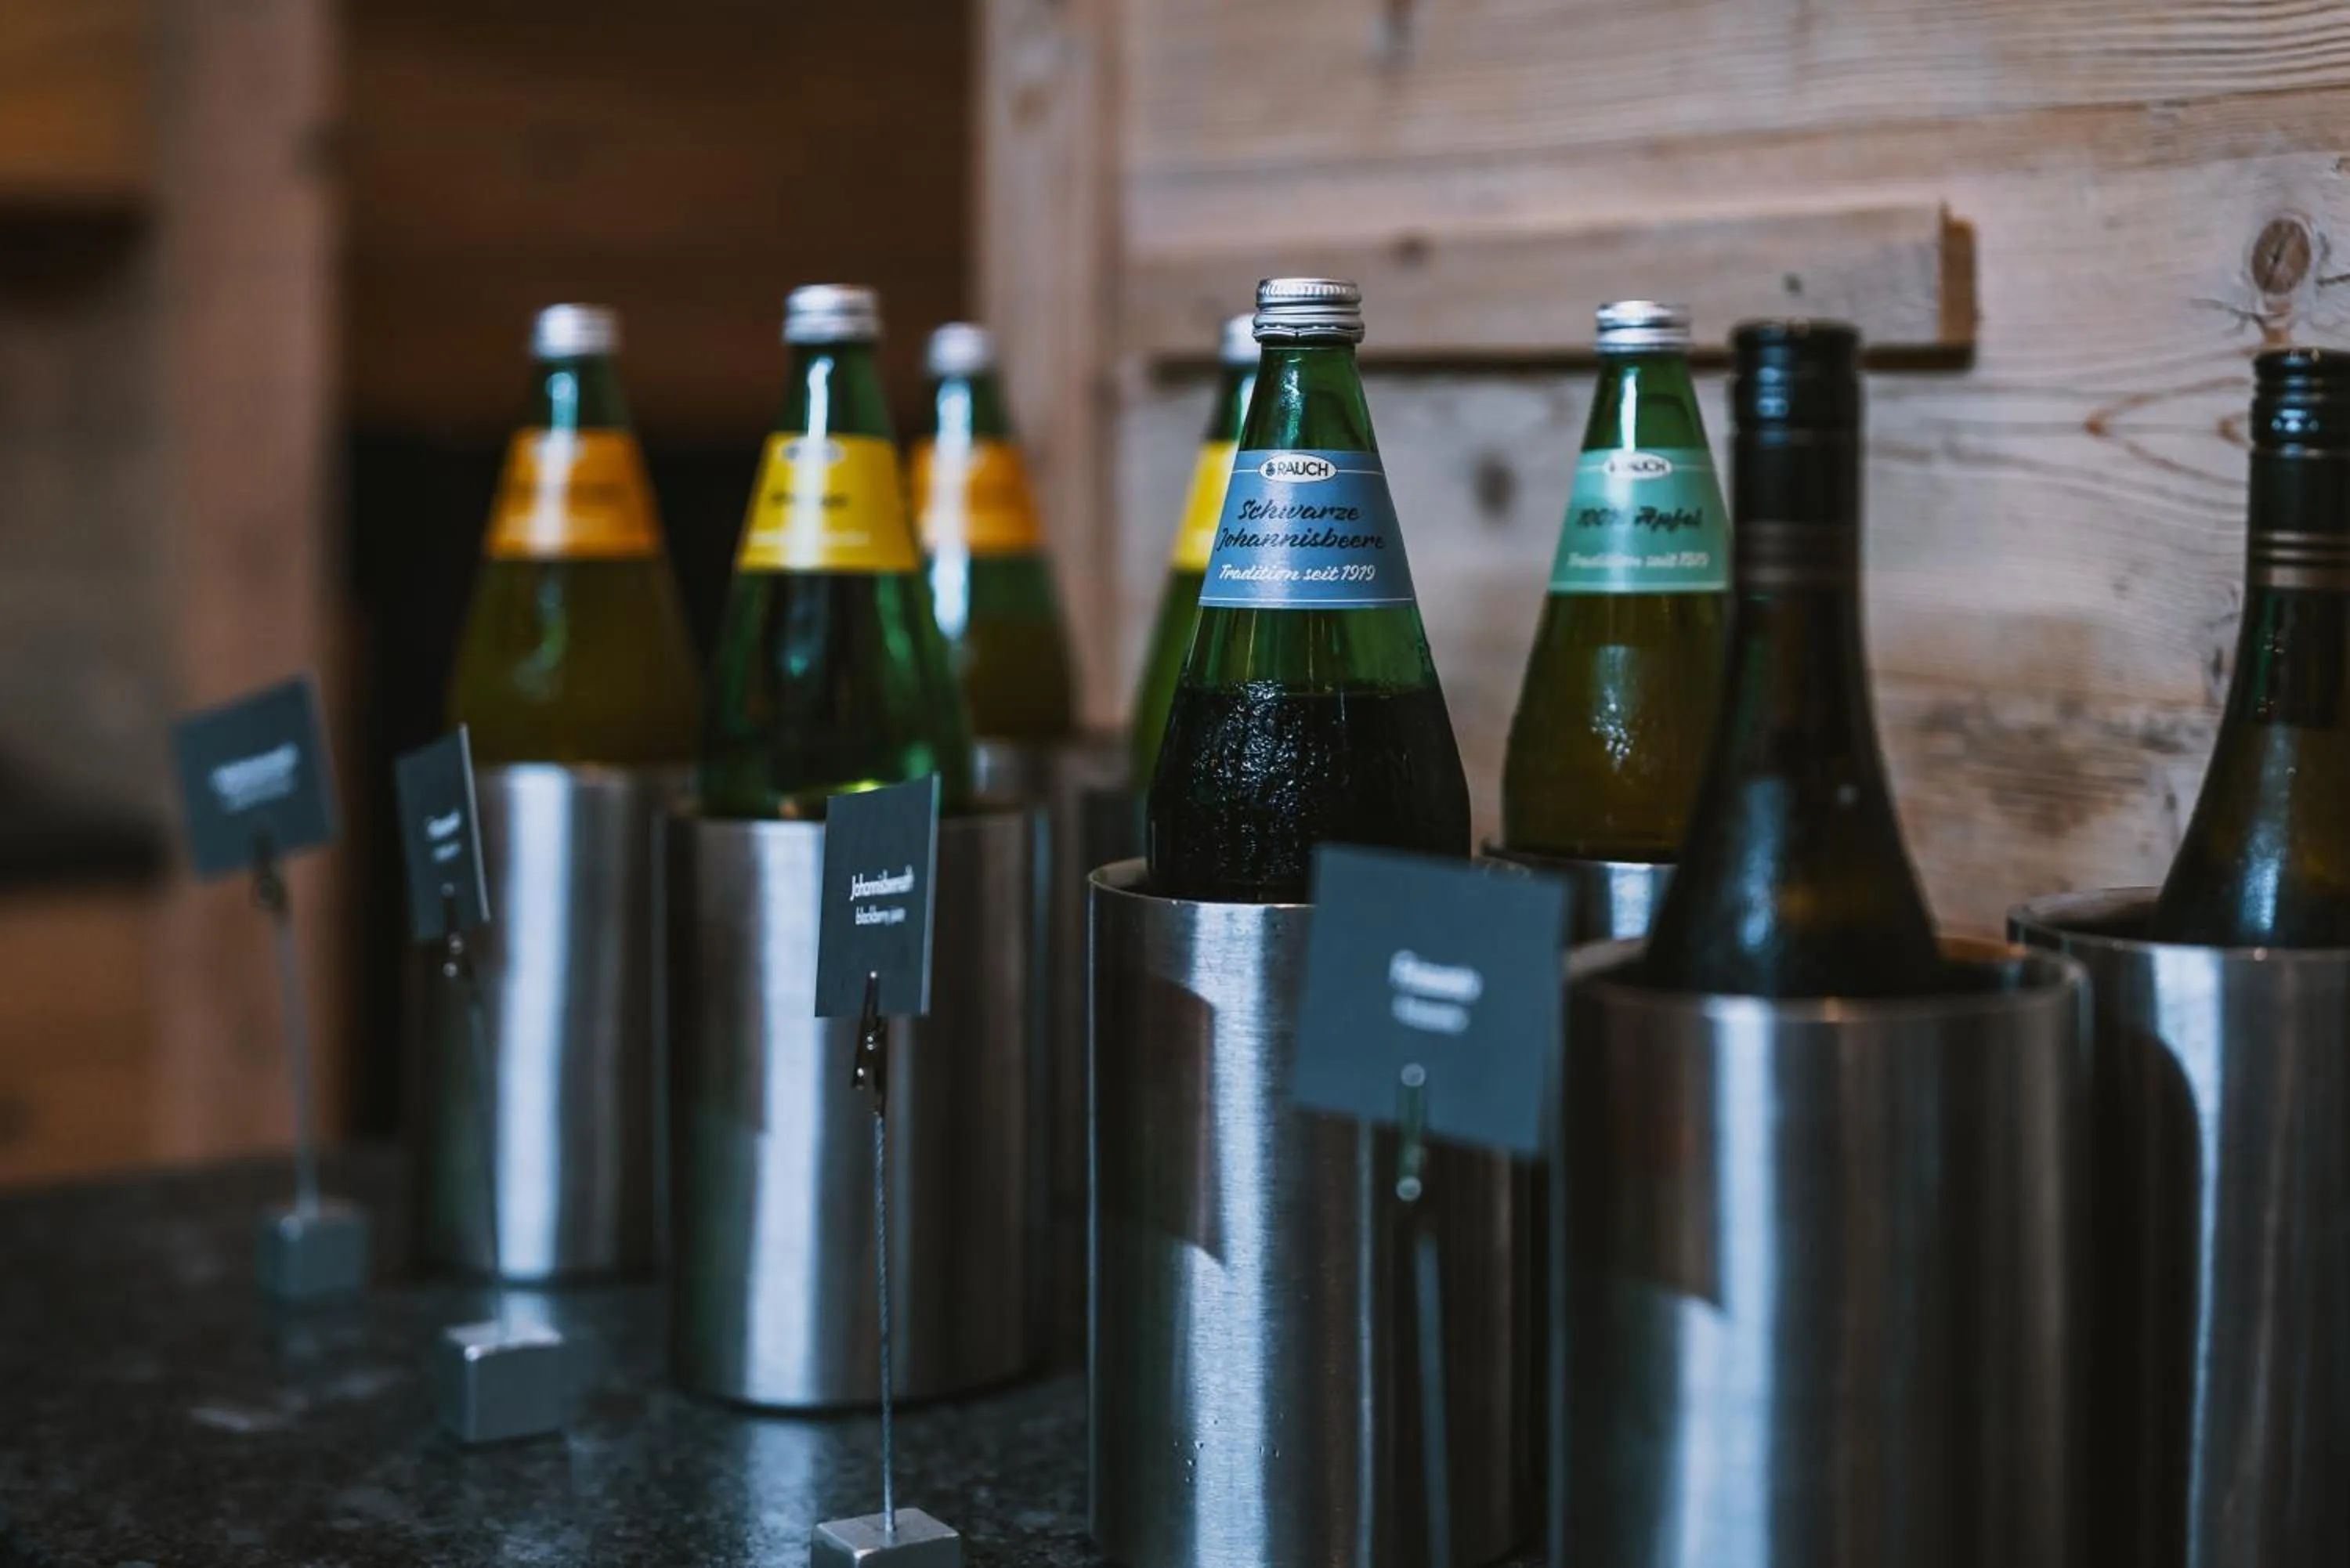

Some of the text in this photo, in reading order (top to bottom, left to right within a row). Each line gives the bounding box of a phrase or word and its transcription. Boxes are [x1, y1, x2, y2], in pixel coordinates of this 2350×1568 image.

[1277, 461, 1329, 476] RAUCH
[1238, 498, 1360, 521] Schwarze
[1216, 527, 1386, 551] Johannisbeere
[1219, 563, 1376, 582] Tradition seit 1919
